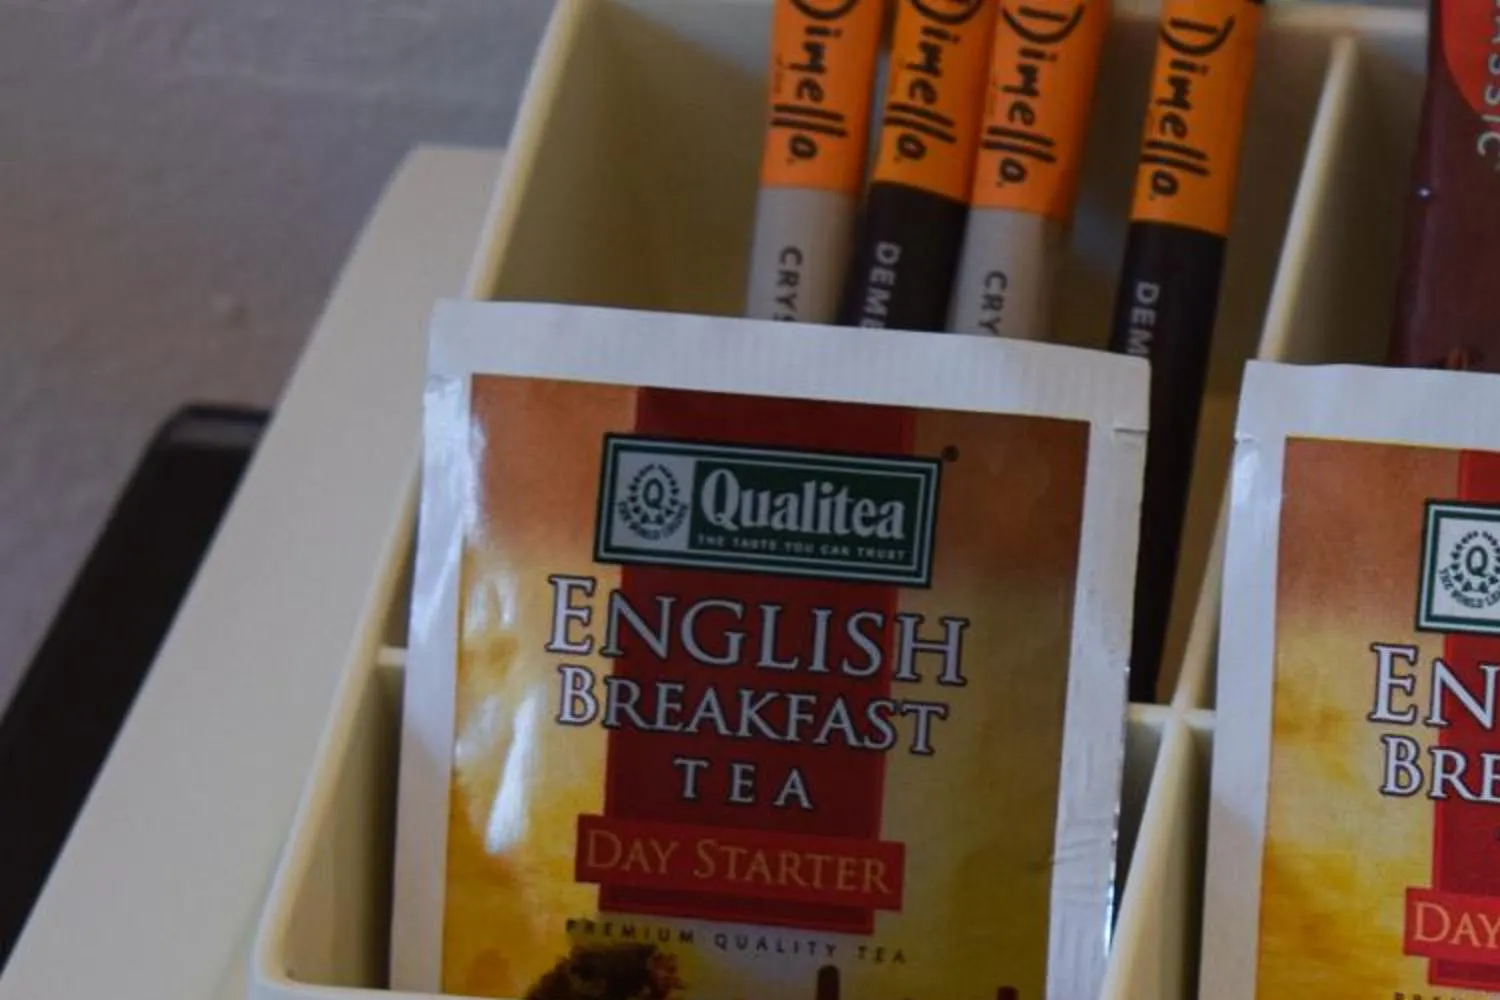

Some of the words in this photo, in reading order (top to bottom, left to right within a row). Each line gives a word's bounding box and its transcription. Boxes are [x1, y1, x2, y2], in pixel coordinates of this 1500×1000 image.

[772, 244, 803, 321] CRY
[702, 468, 906, 541] Qualitea
[546, 574, 969, 686] ENGLISH
[557, 665, 947, 756] BREAKFAST
[673, 757, 814, 810] TEA
[584, 829, 680, 875] DAY
[693, 839, 893, 896] STARTER
[565, 918, 696, 944] PREMIUM
[714, 933, 838, 958] QUALITY
[857, 945, 907, 964] TEA
